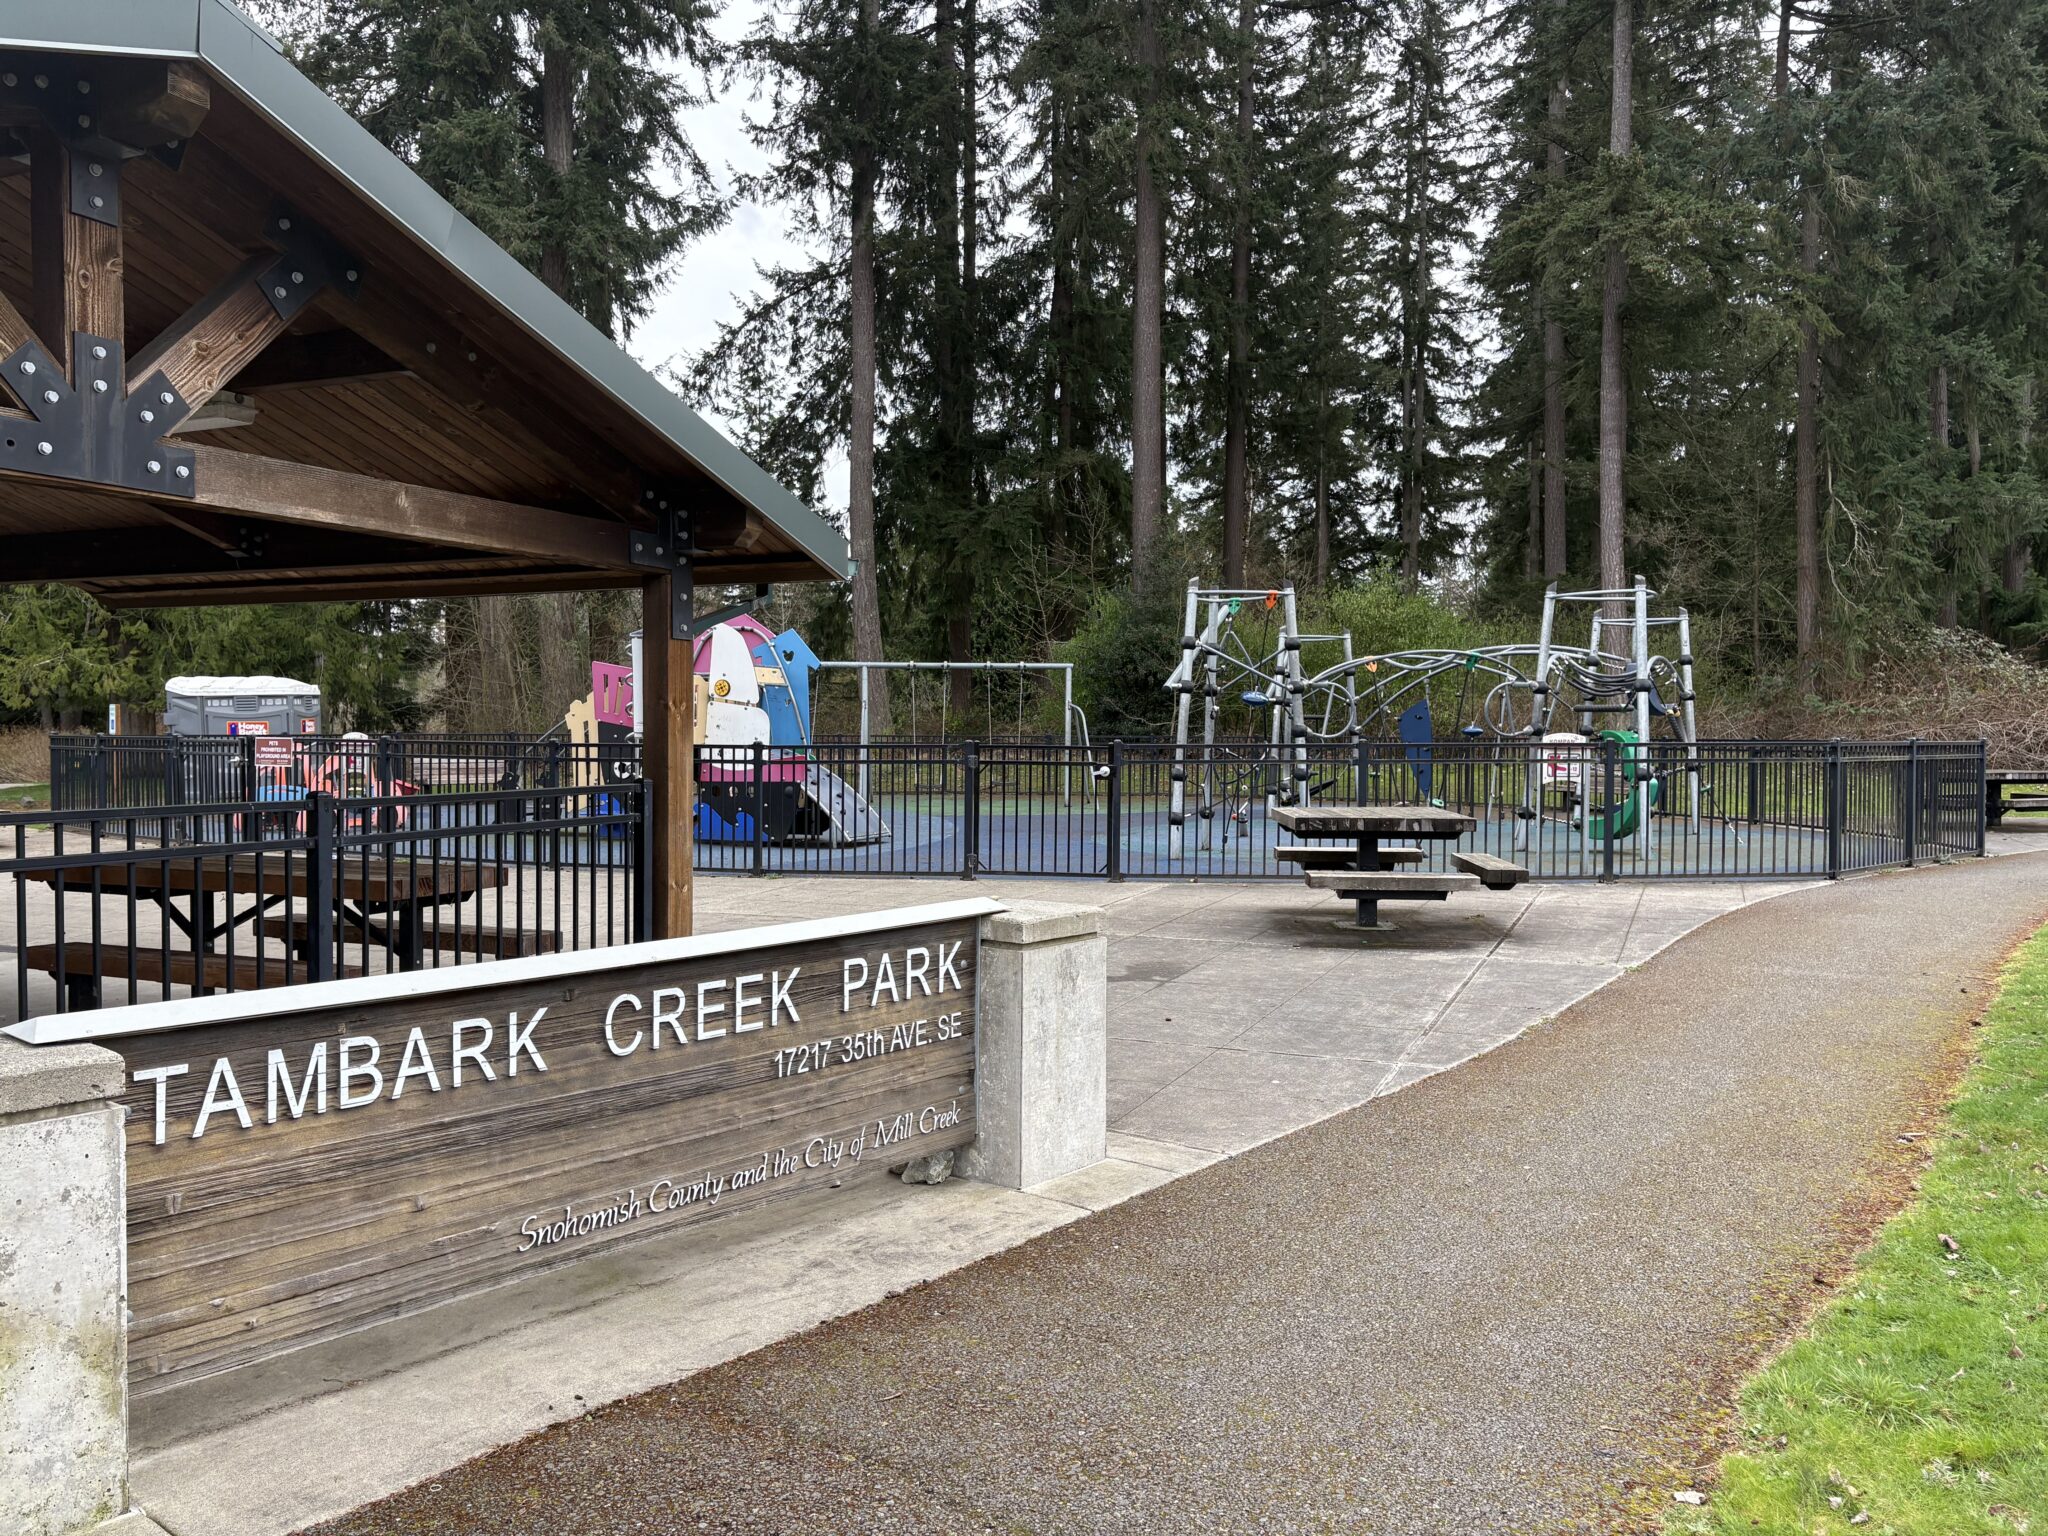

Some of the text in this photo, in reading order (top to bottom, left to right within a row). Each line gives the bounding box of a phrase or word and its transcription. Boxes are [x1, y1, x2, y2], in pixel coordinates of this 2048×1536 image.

[239, 722, 264, 731] Honey
[133, 940, 962, 1146] TAMBARK CREEK PARK
[774, 1011, 962, 1078] 17217 35th AVE. SE
[517, 1100, 961, 1252] Snohomish County and the City of Mill Creek
